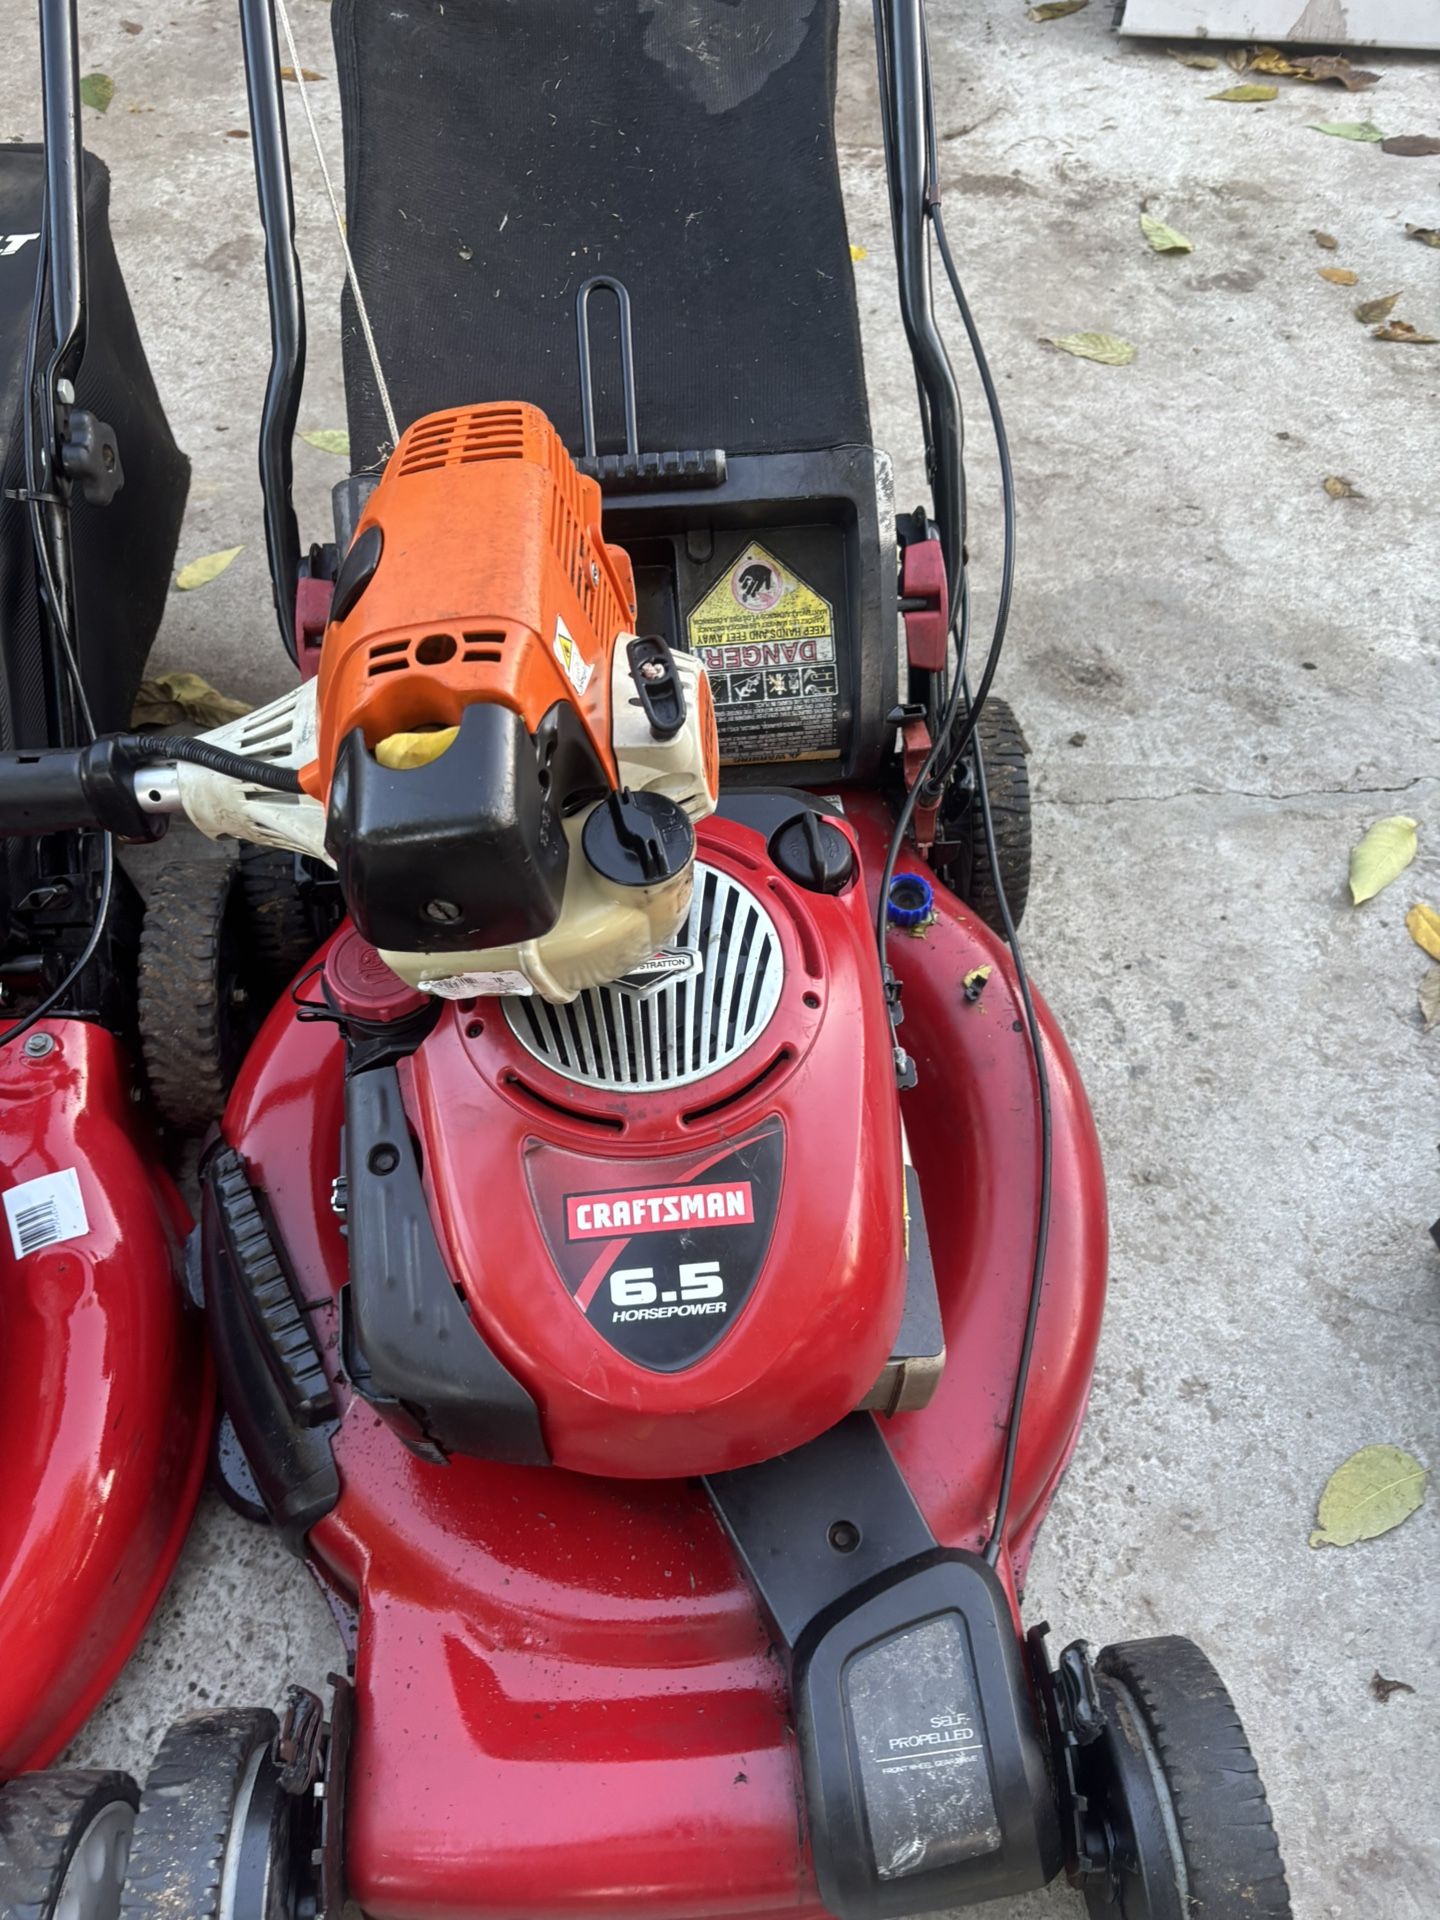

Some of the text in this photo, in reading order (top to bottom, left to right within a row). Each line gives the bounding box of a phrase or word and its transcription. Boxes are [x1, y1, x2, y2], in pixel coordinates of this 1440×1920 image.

[696, 625, 825, 644] KEEP HANDS AND FEET AWAY
[706, 642, 816, 668] DANGER
[640, 959, 685, 969] STRATTON
[576, 1190, 745, 1230] CRAFTSMAN
[610, 1261, 723, 1307] 6.5
[612, 1301, 727, 1323] HORSEPOWER
[889, 1728, 974, 1750] PROPELLED
